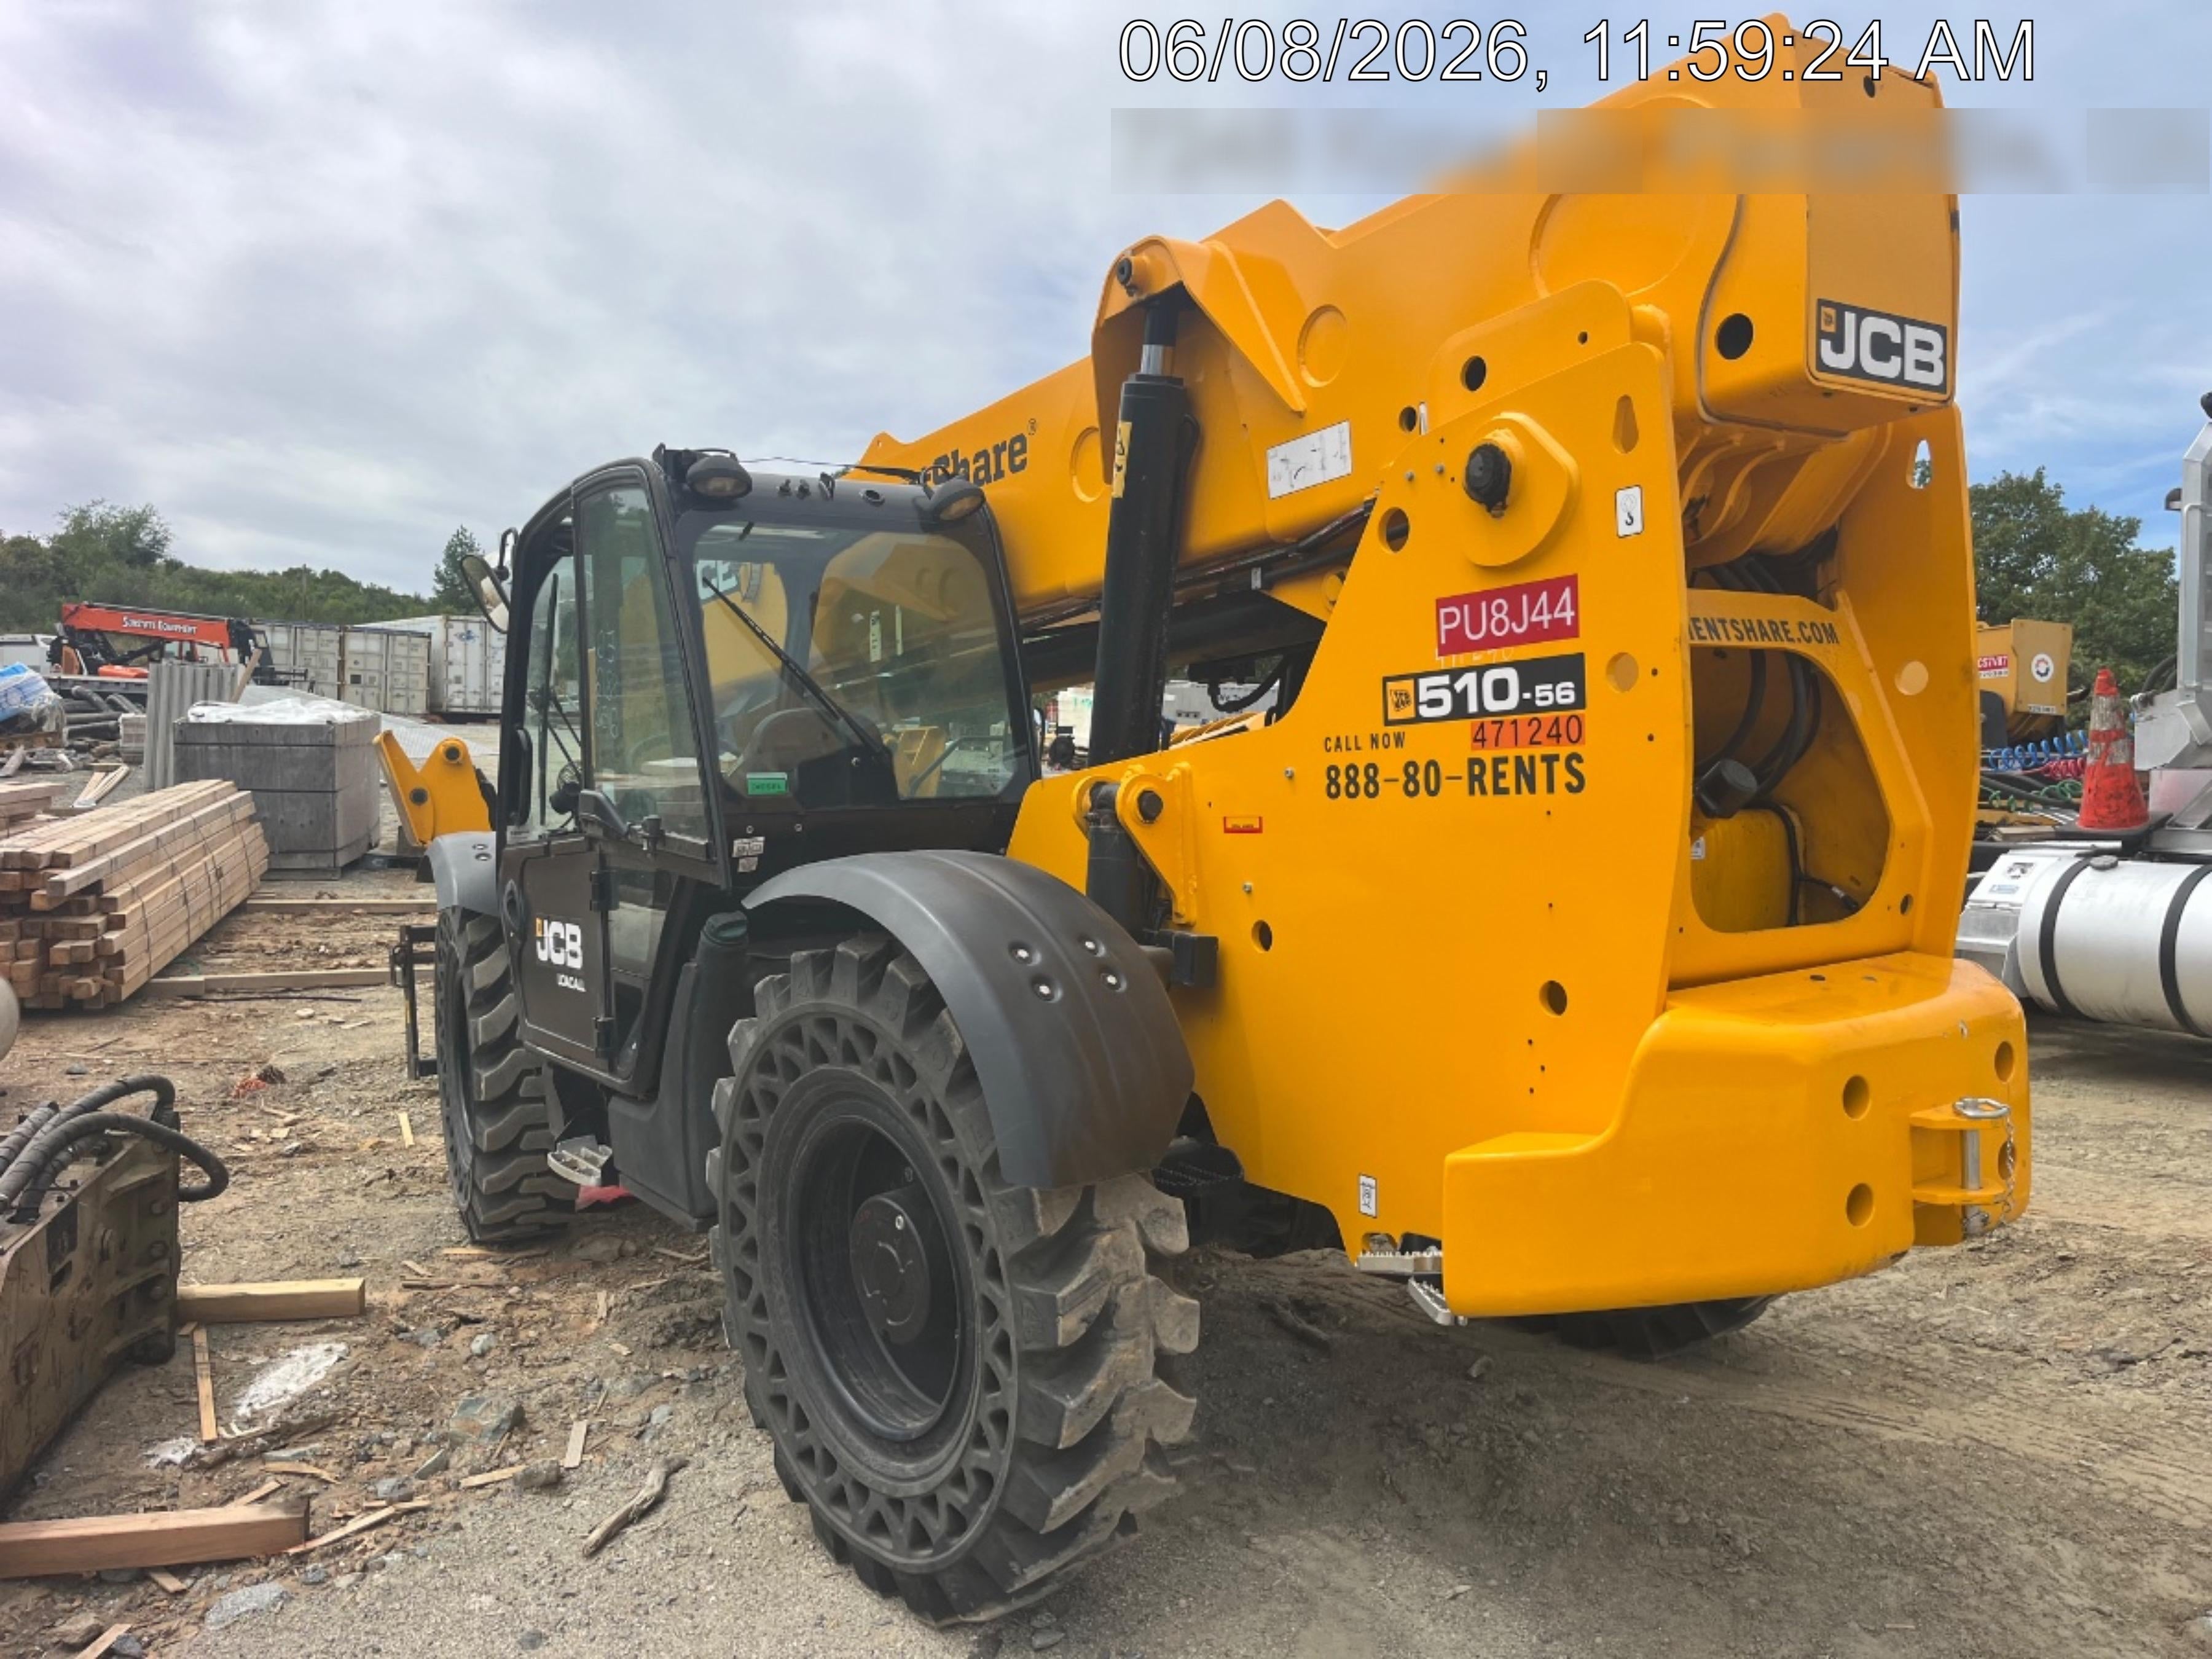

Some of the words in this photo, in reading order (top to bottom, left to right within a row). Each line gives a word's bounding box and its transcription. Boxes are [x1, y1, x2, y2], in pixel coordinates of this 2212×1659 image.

[1820, 311, 1944, 386] JCB
[927, 433, 1027, 486] Share
[1439, 587, 1575, 644] PU8J44
[1418, 667, 1575, 718] 510-56
[1324, 734, 1362, 753] CALL
[1371, 732, 1406, 749] NOW
[1473, 715, 1582, 747] 471240
[1325, 752, 1586, 799] 888-80-RENTS
[536, 919, 583, 969] JCB
